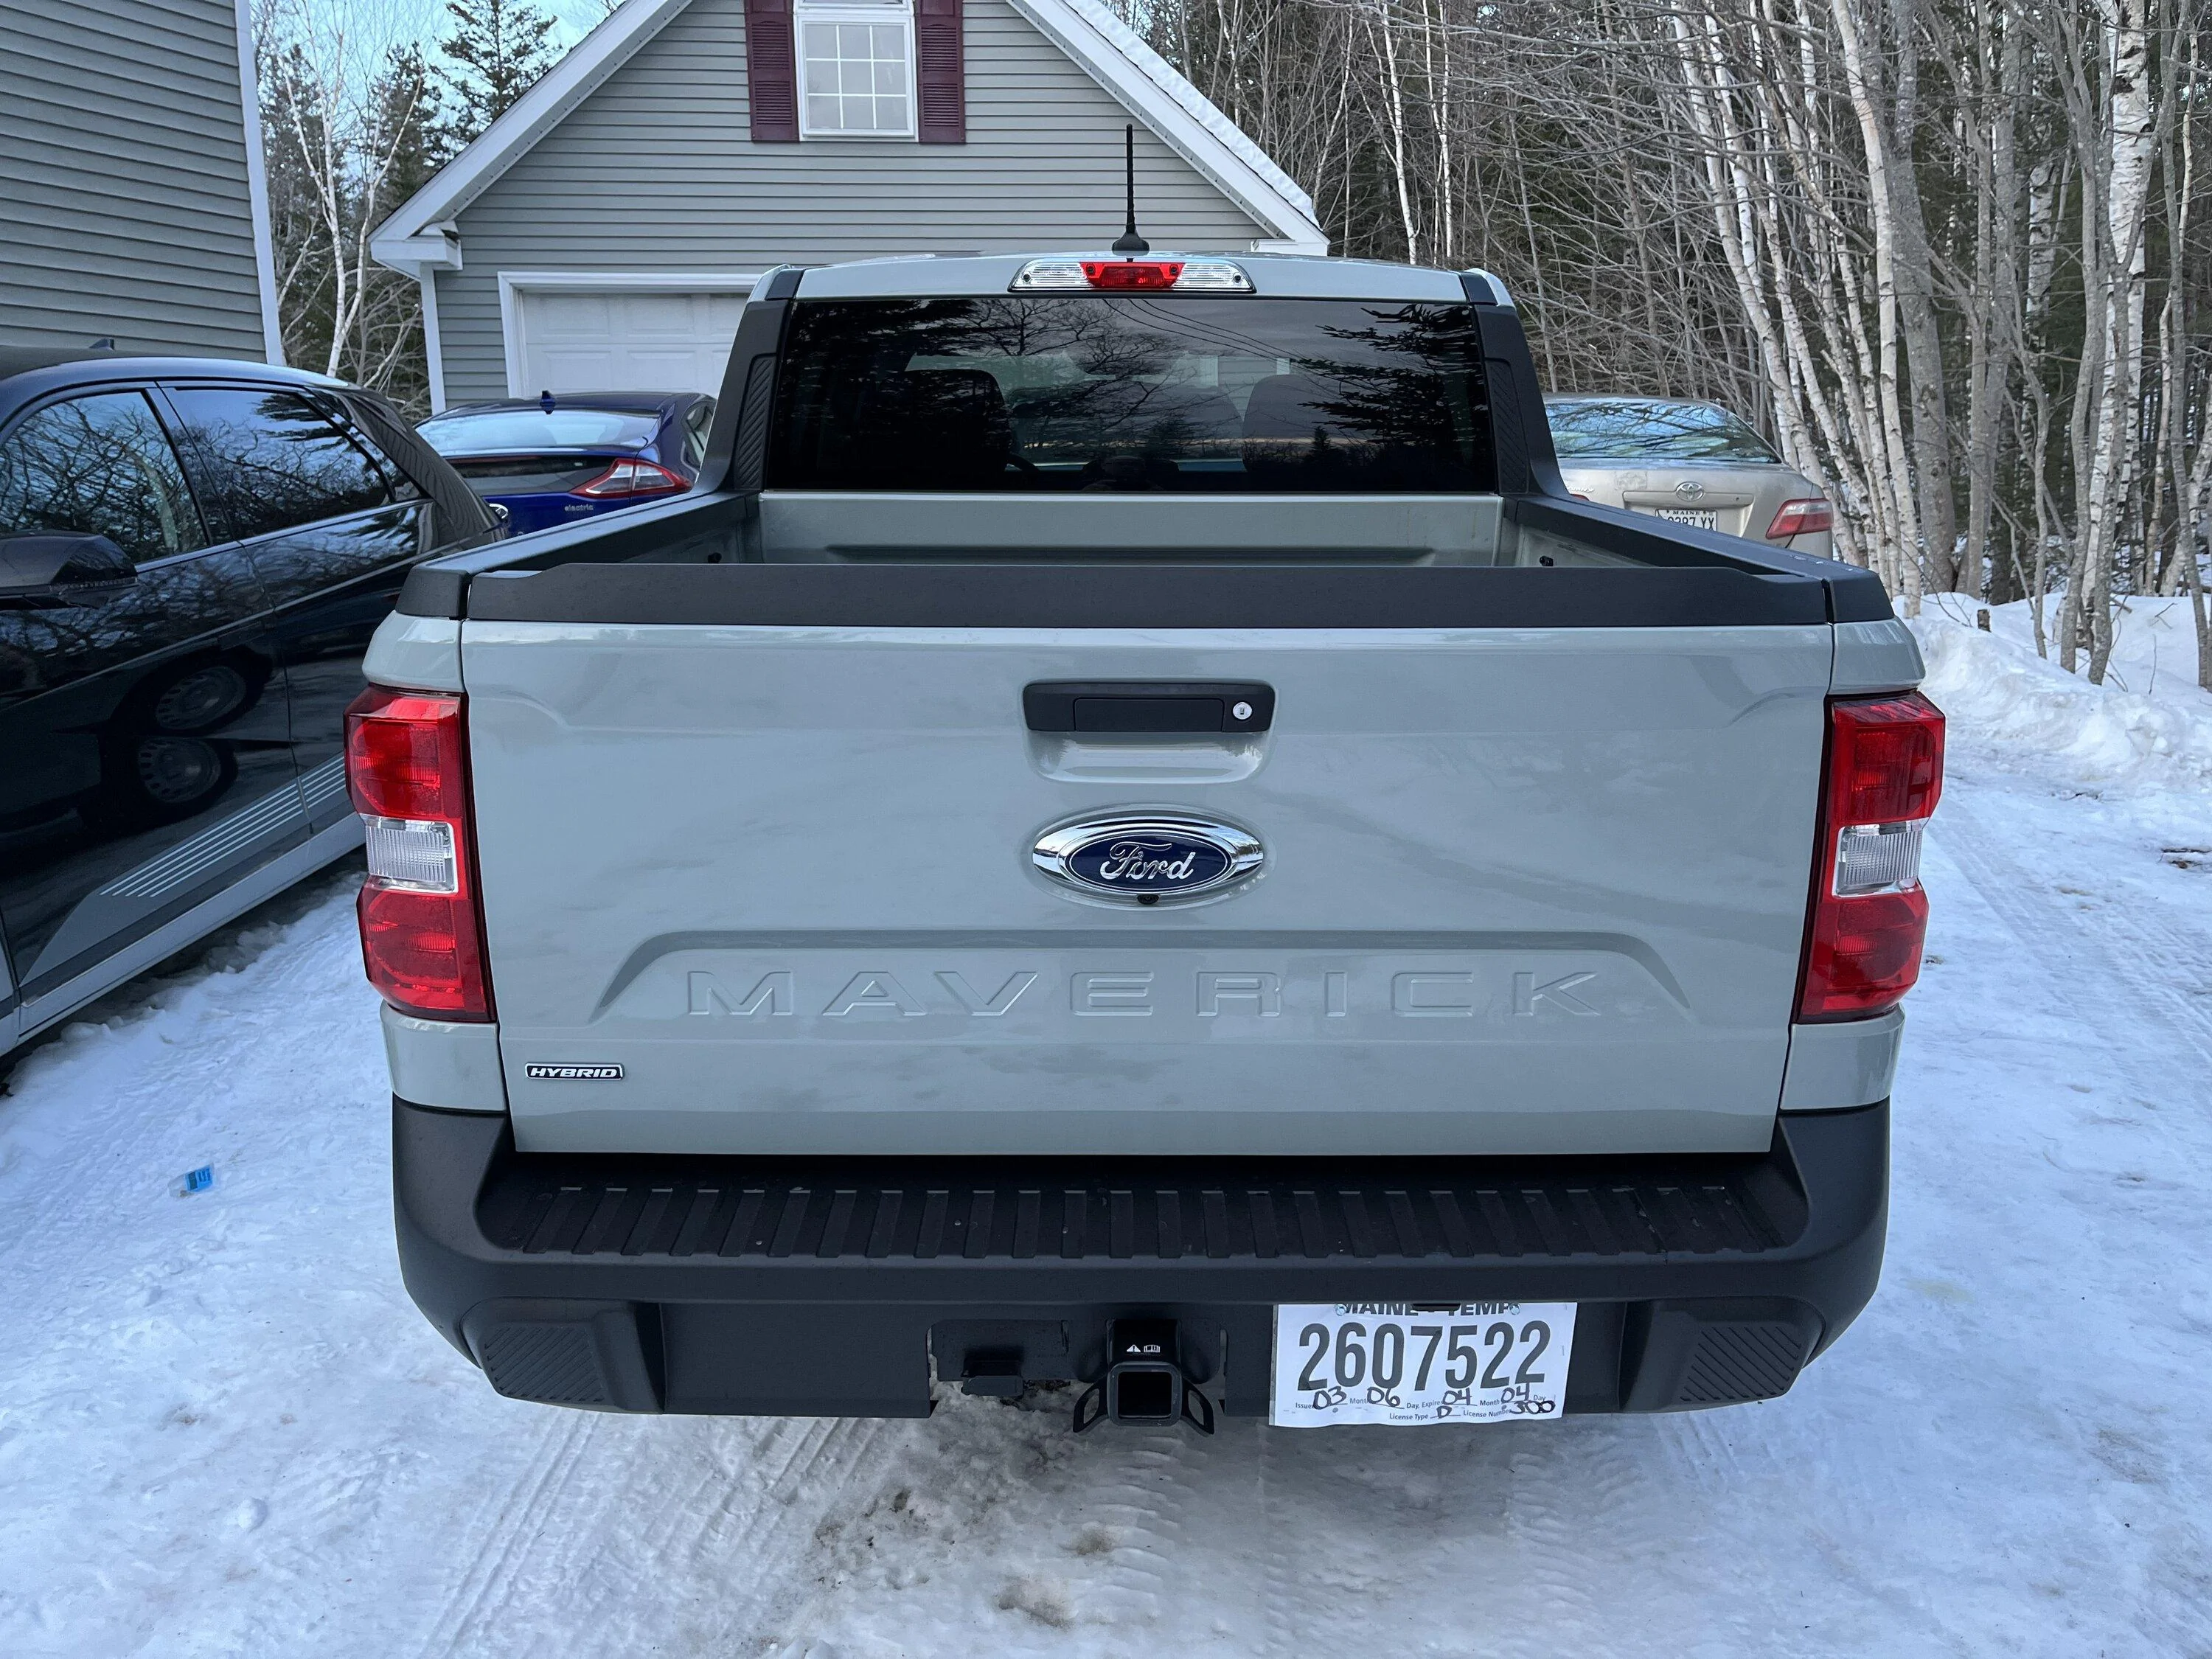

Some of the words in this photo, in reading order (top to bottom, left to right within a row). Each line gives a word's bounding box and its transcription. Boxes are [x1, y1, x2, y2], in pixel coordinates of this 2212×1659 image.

[1099, 841, 1196, 880] Ford
[688, 971, 1601, 1016] MAVERICK
[530, 1068, 617, 1078] HYBRID
[1448, 1303, 1512, 1315] EMP
[1298, 1321, 1551, 1391] 2607522
[1312, 1386, 1347, 1410] 03
[1366, 1386, 1401, 1408] 06
[1441, 1388, 1472, 1405] 04
[1488, 1409, 1512, 1417] Numbe
